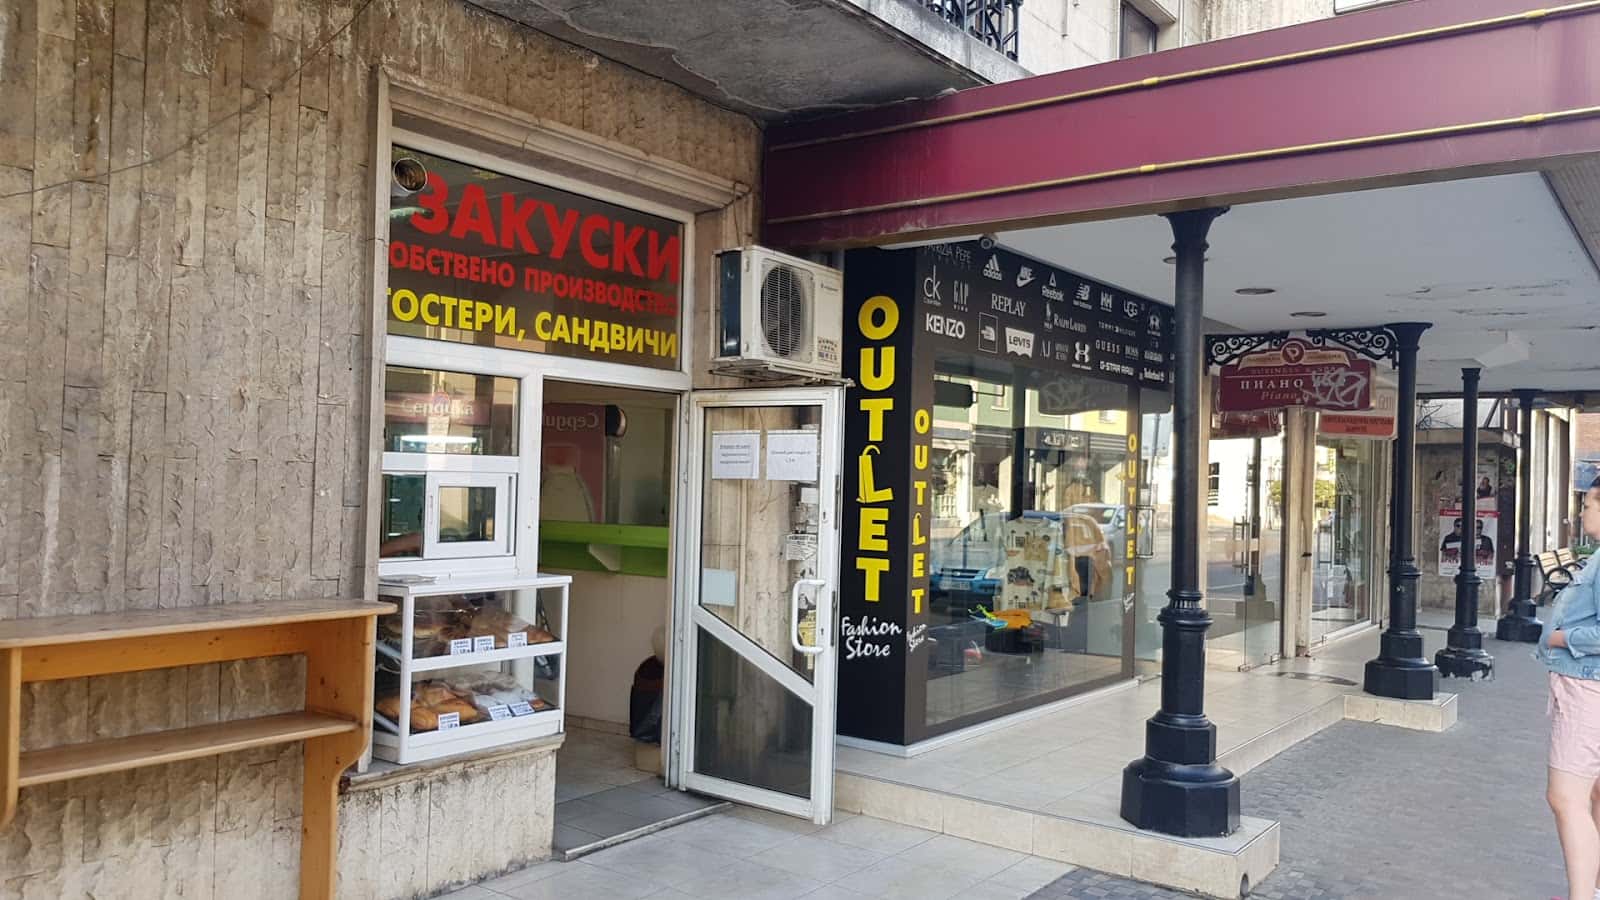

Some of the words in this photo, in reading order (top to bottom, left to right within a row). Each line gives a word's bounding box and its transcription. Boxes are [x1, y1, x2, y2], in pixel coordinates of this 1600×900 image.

[410, 172, 680, 285] ЗАКУСКИ
[991, 293, 1026, 318] REPLAY
[535, 311, 678, 358] САНДВИЧИ
[926, 312, 966, 340] KENZO
[1095, 339, 1121, 355] GUESS
[855, 295, 900, 602] OUTLET
[911, 409, 930, 614] OUTLET
[1126, 434, 1137, 585] OUTLET
[841, 615, 902, 637] Fashion
[846, 635, 890, 660] Store
